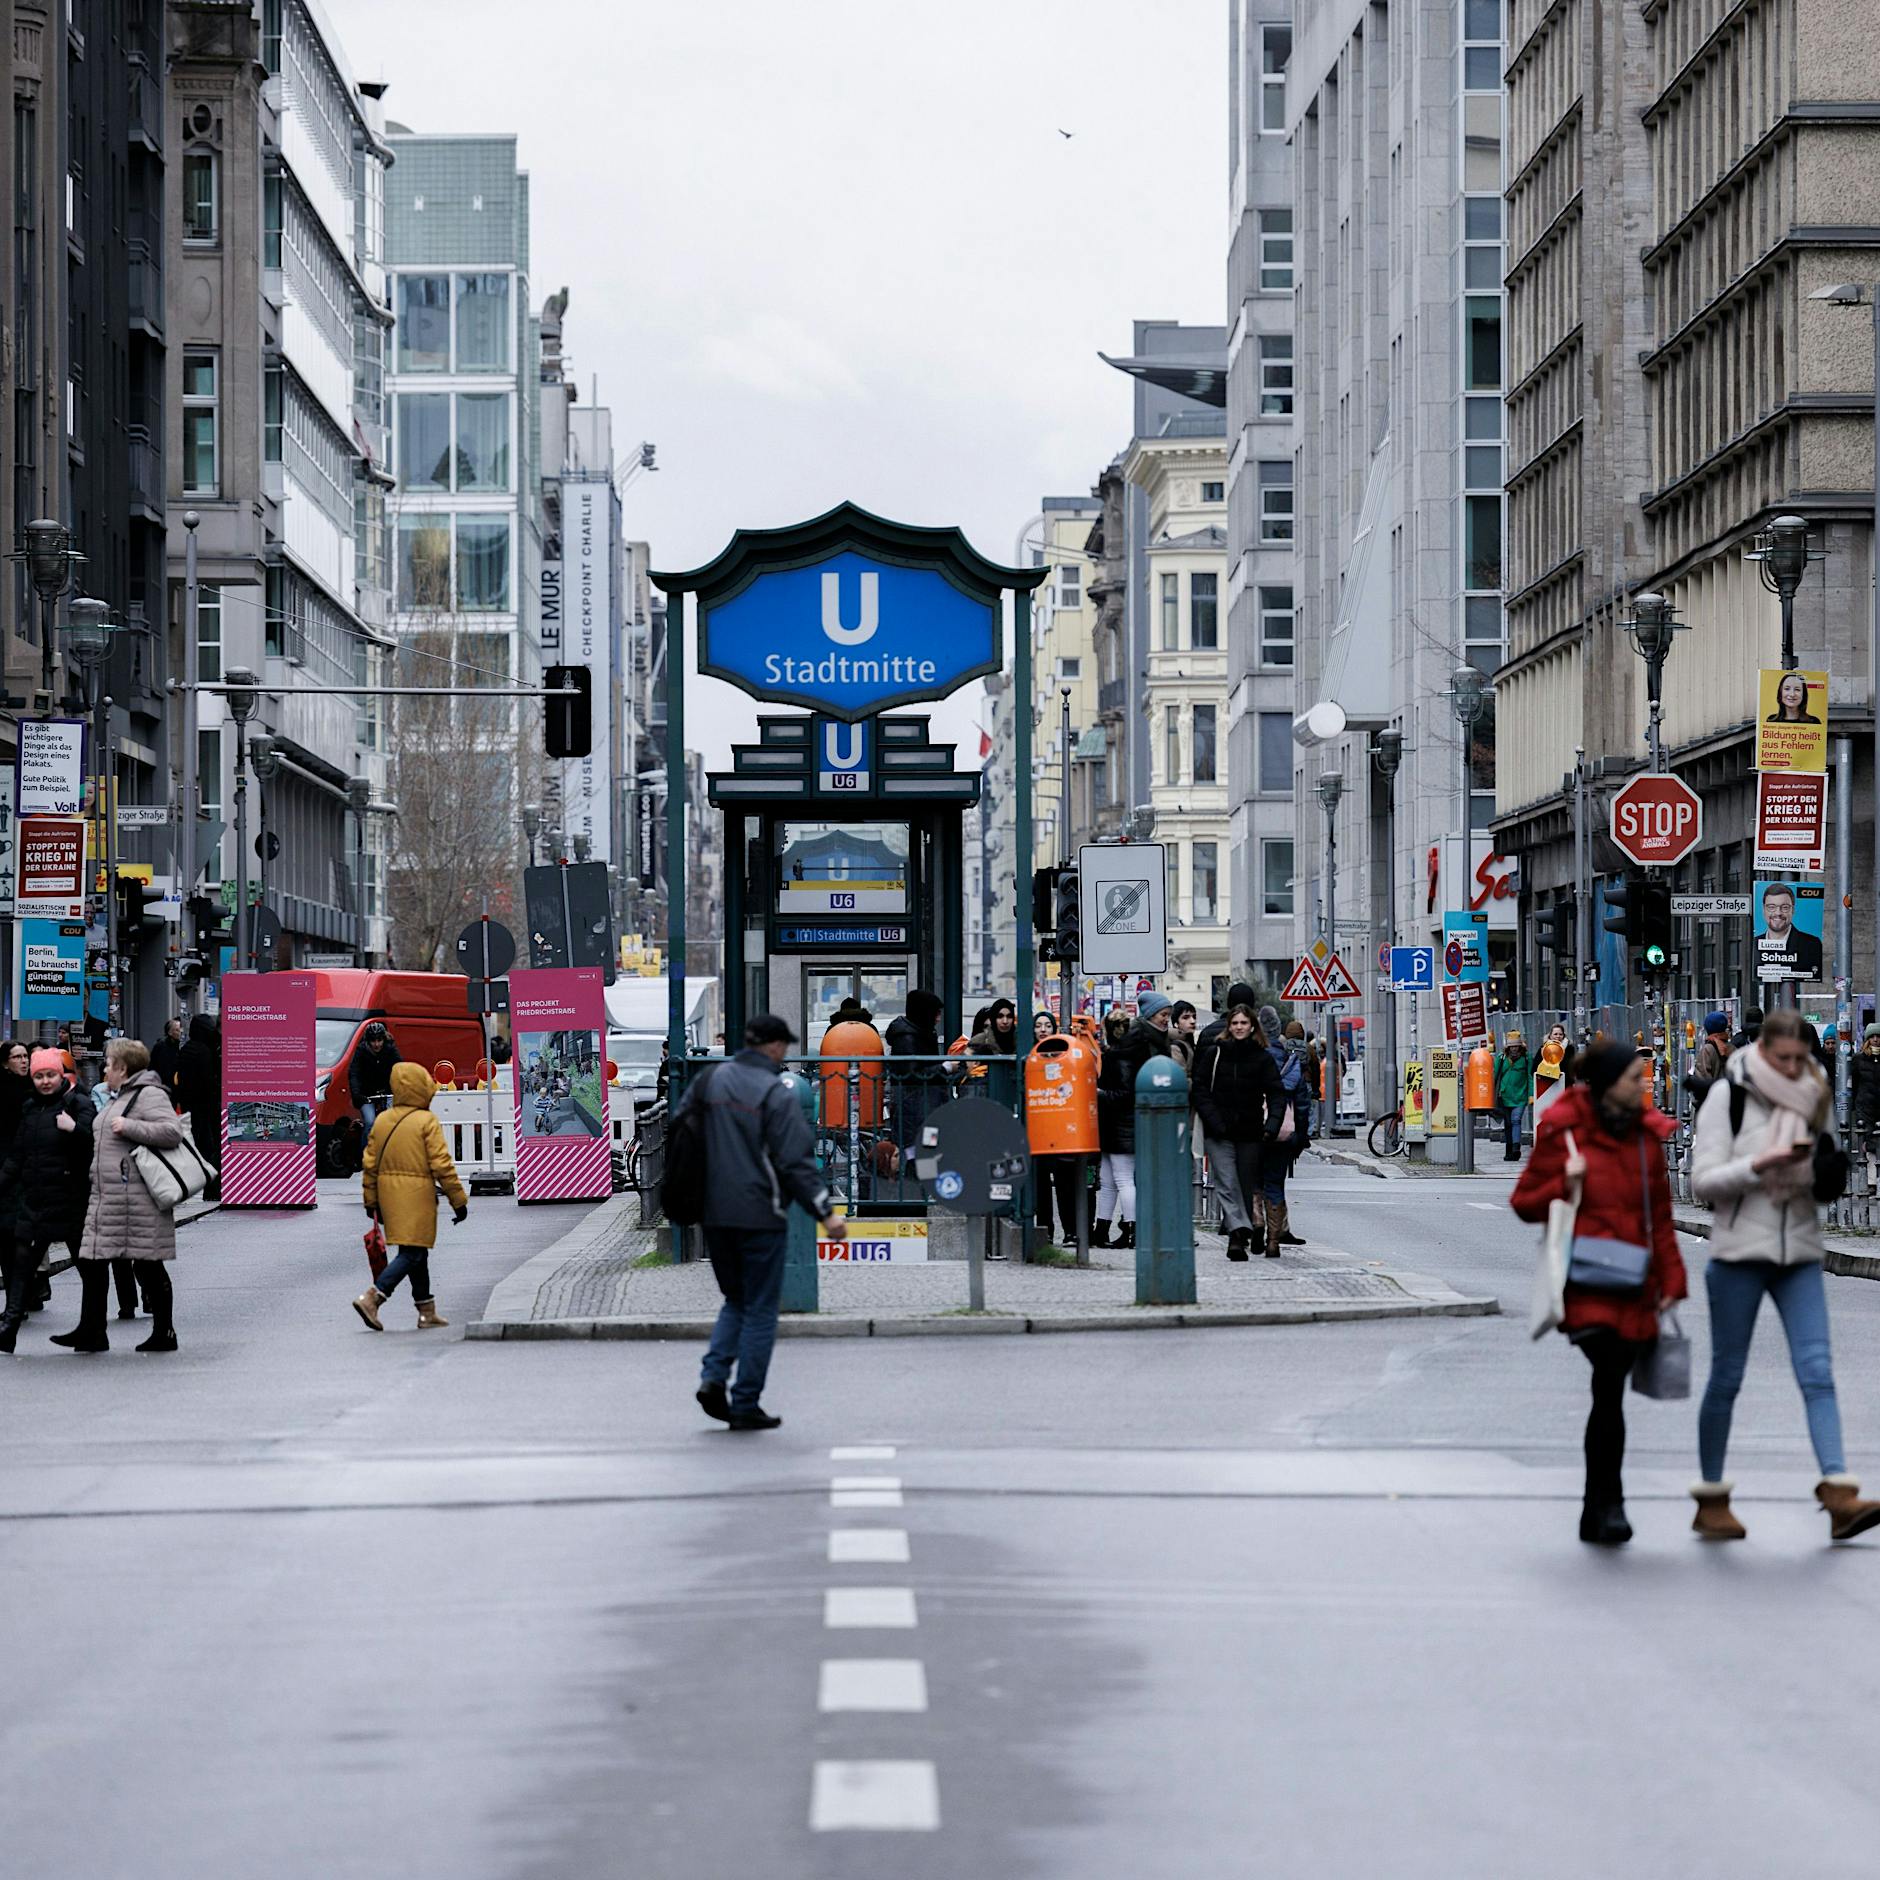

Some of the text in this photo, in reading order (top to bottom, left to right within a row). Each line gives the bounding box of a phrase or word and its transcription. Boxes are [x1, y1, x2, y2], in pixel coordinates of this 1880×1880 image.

[542, 570, 560, 620] MUR
[821, 572, 880, 646] U
[542, 628, 560, 649] LE
[582, 493, 592, 798] MUSE CHECKPOINT CHARLIE
[765, 652, 936, 684] Stadtmitte
[35, 724, 50, 733] gibt
[24, 733, 63, 742] wichtigere
[1762, 730, 1821, 741] Bildung heißt
[24, 742, 46, 750] Dinge
[826, 722, 862, 769] U
[1762, 751, 1792, 759] lernen.
[834, 775, 855, 787] U6
[54, 802, 77, 813] Volt
[1766, 805, 1817, 815] KRIEG IN
[118, 810, 164, 821] ziger Straße
[1621, 802, 1693, 836] STOP
[25, 852, 76, 862] KRIEG IN
[833, 895, 853, 907] U6
[1672, 899, 1746, 912] Leipziger Straße
[818, 930, 899, 941] Stadtmitte U6
[28, 948, 55, 957] Berlin,
[1761, 952, 1797, 962] Schaal
[41, 960, 78, 969] brauchst
[1414, 958, 1426, 980] P
[28, 972, 63, 982] günstige
[28, 984, 78, 994] Wohnungen.
[817, 1243, 888, 1261] U2 U6
